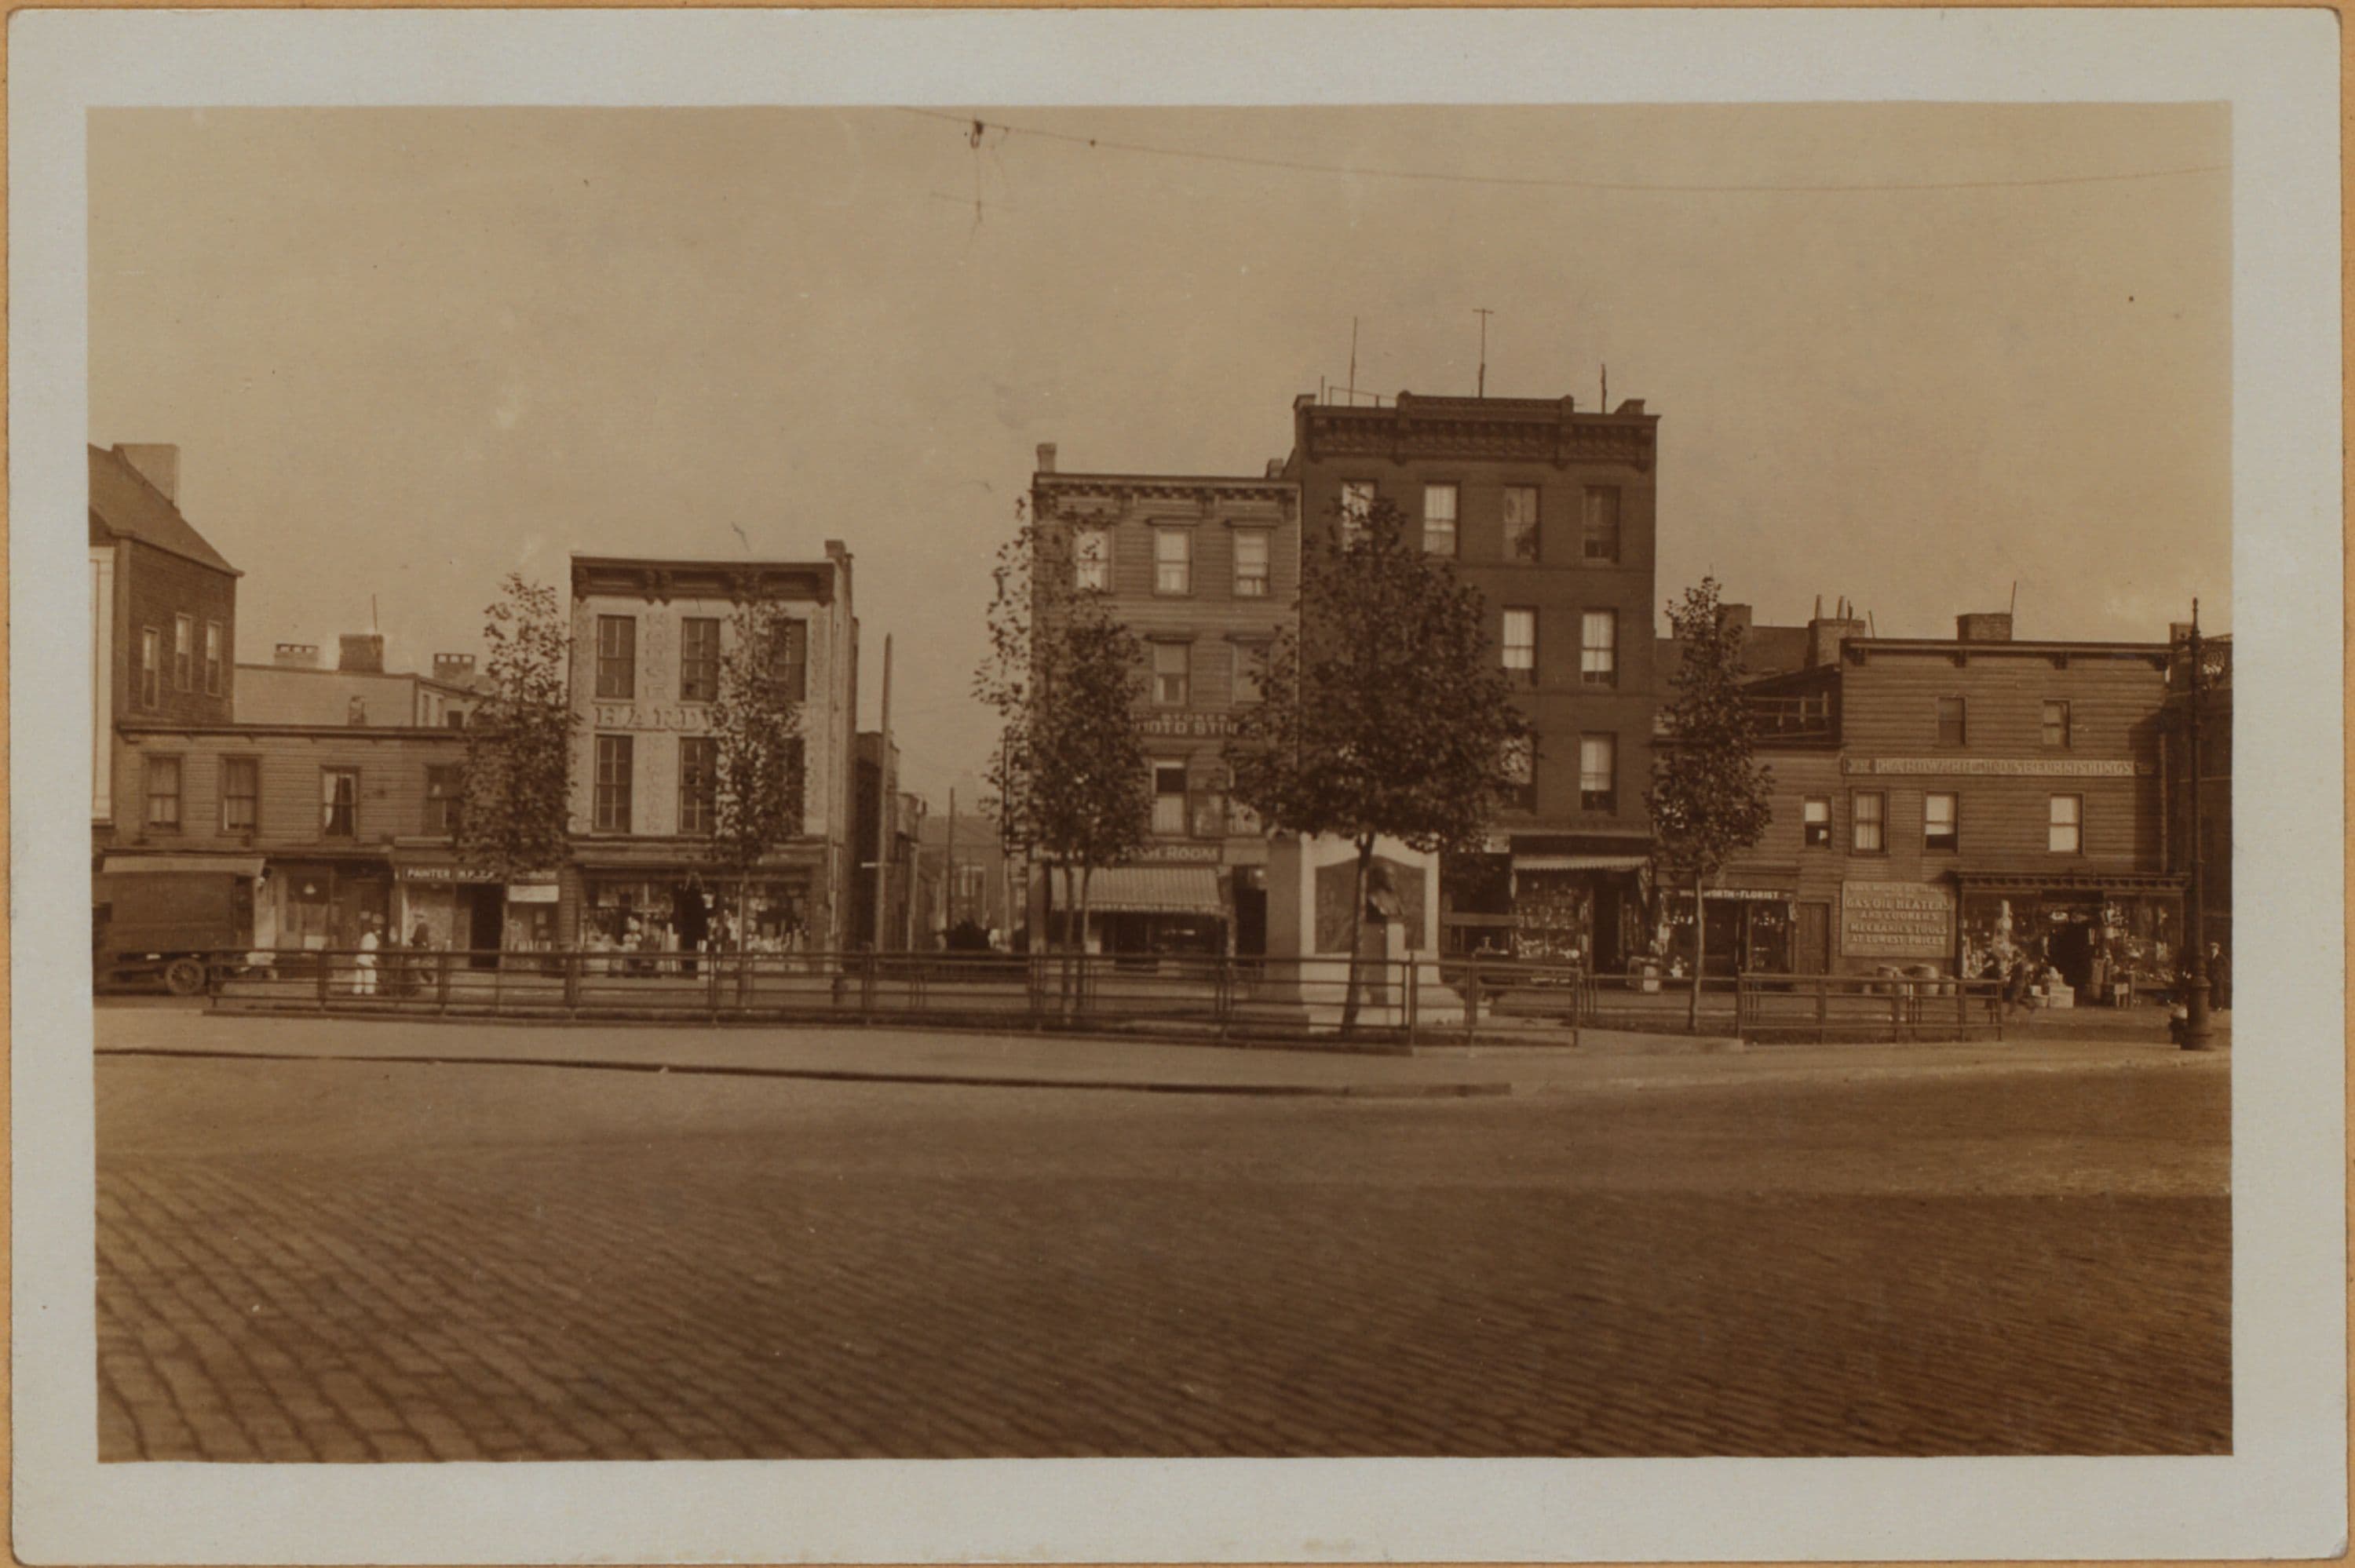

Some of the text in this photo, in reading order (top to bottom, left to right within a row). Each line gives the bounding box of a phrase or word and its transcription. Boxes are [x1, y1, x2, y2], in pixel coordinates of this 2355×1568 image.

[1166, 845, 1218, 861] ROOM
[1740, 890, 1779, 899] FLORIST
[1896, 899, 1949, 910] HEATERS
[1914, 924, 1948, 935] TOOLS
[1865, 935, 1904, 944] LOWEST
[1907, 935, 1947, 946] PRICES
